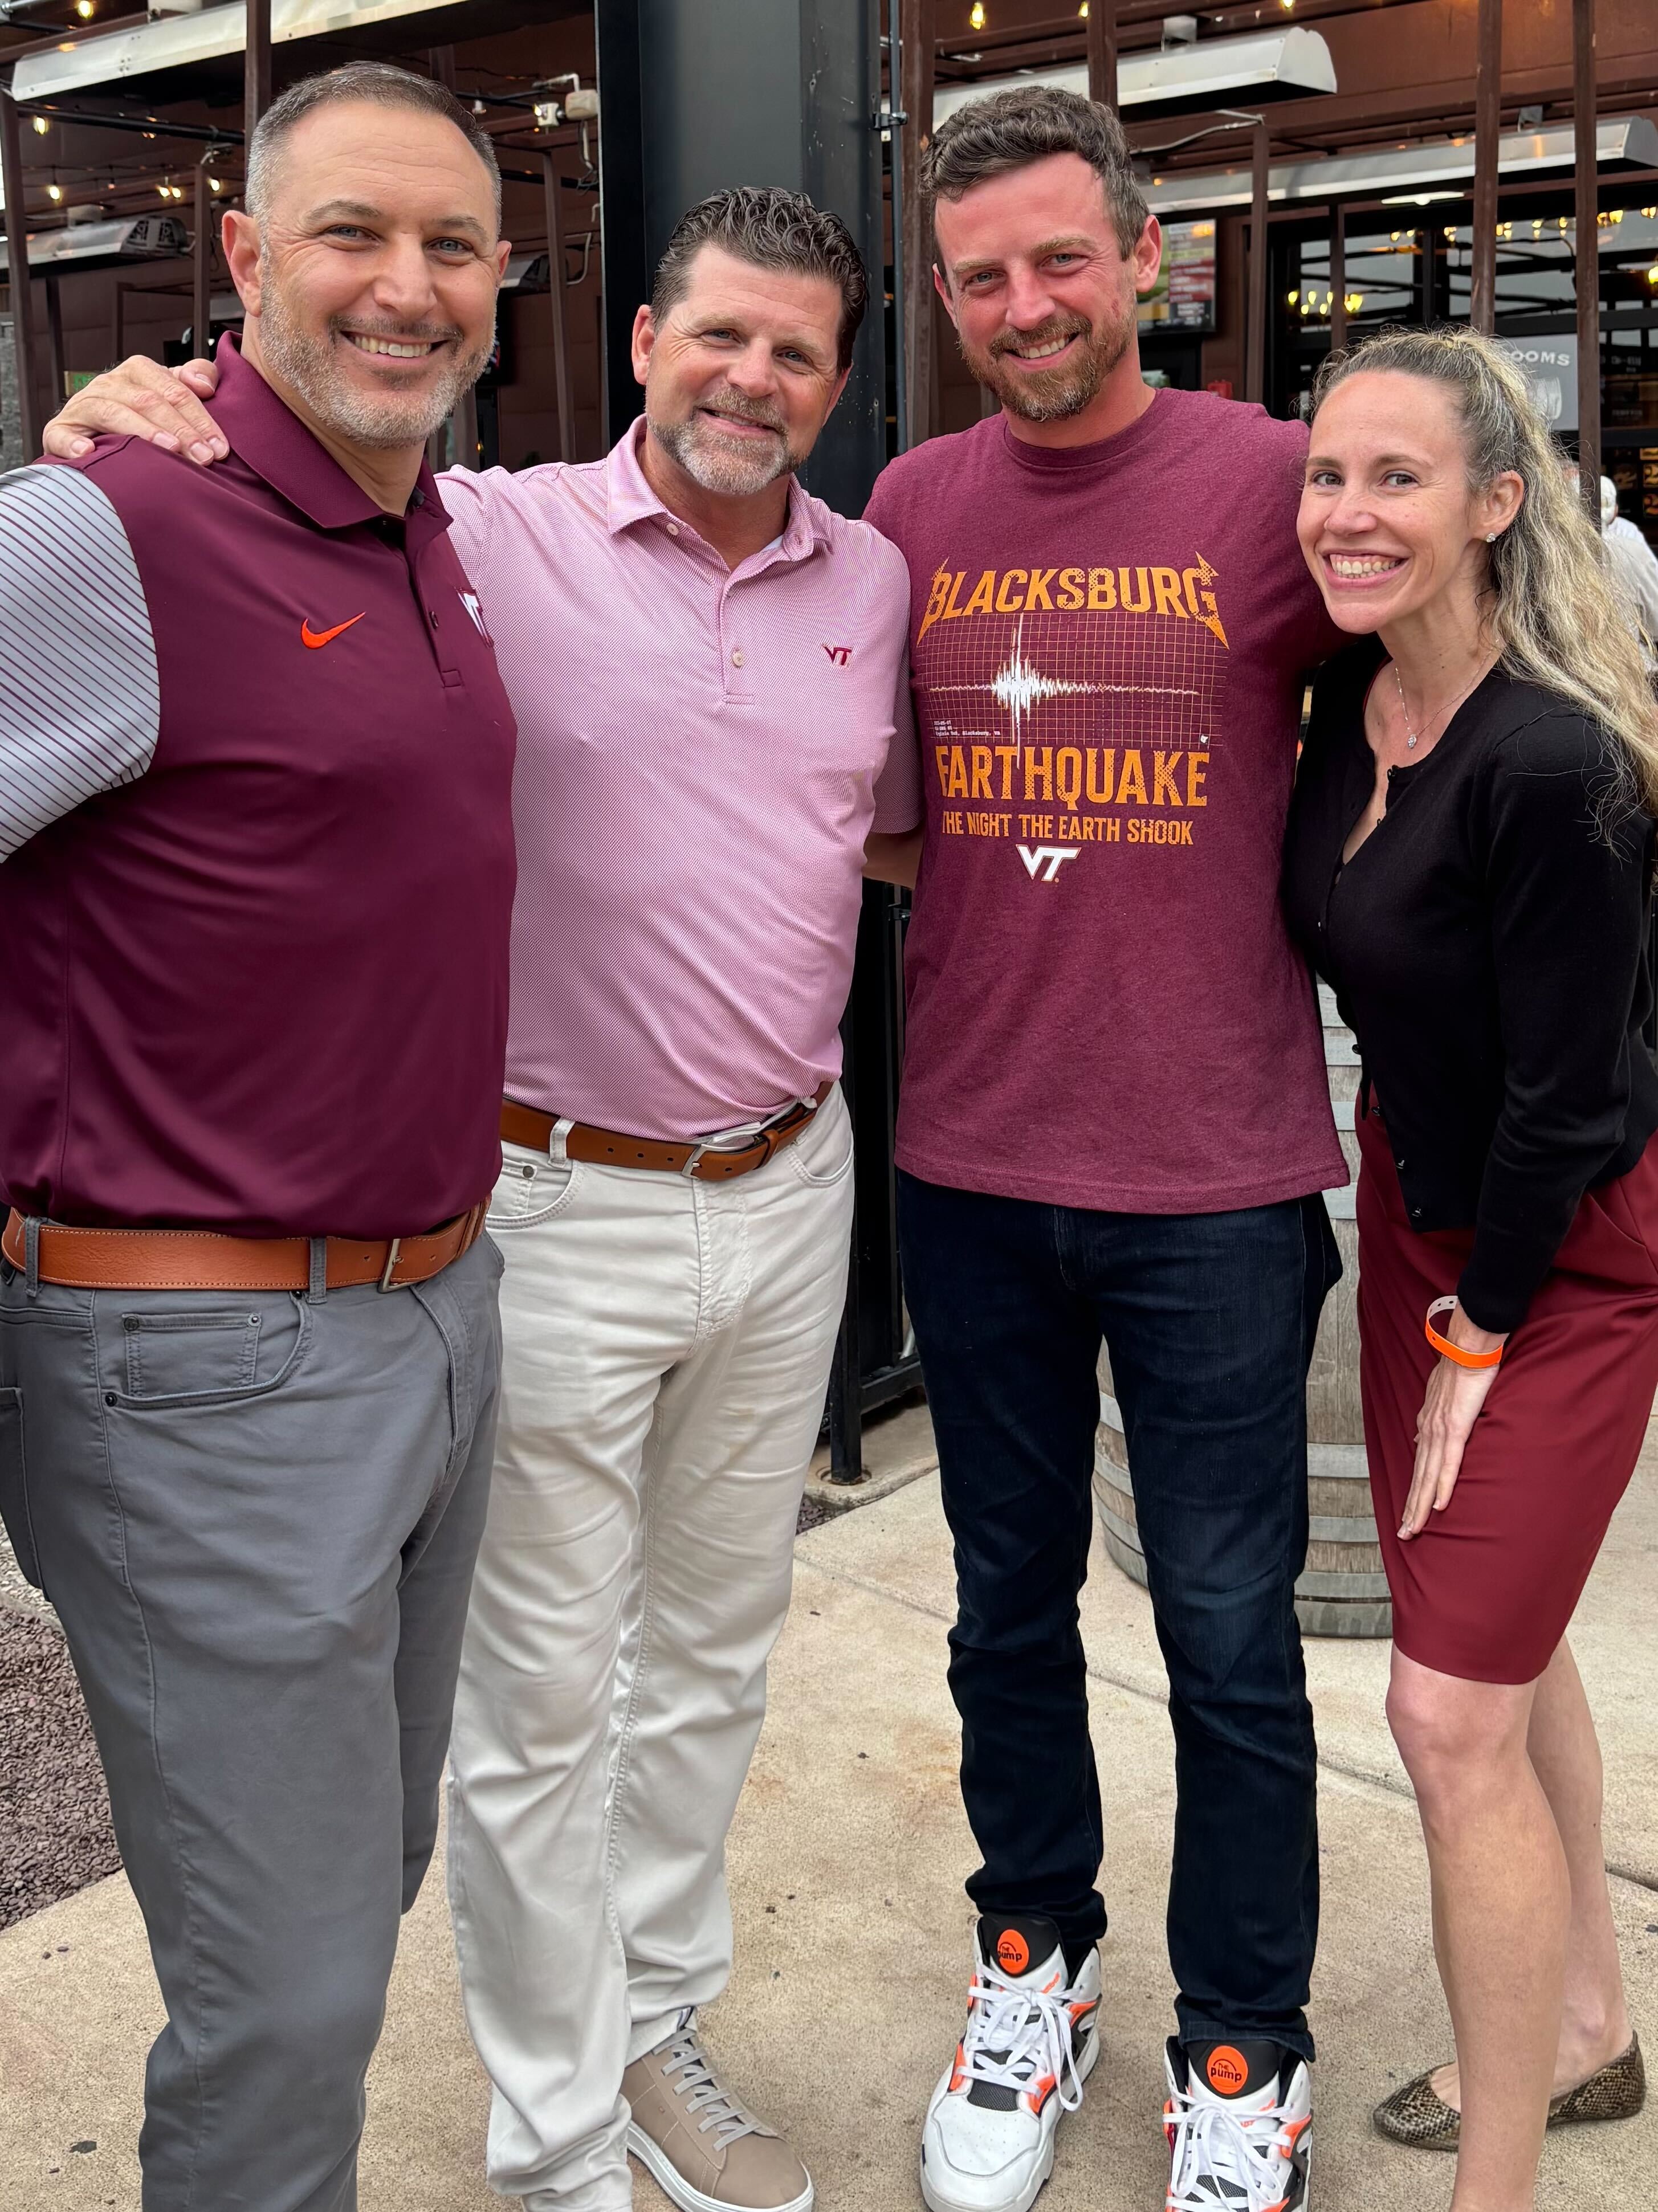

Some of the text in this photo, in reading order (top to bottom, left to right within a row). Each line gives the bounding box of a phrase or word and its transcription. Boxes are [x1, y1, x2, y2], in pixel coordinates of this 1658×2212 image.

[1510, 350, 1570, 366] OOMS
[916, 551, 1229, 650] BLACKSBURG
[821, 643, 852, 666] VT
[935, 745, 1209, 810] EARTHQUAKE
[966, 811, 1012, 837] NIGHT
[1018, 814, 1053, 838] THE
[1058, 815, 1121, 842] EARTH
[1127, 819, 1194, 846] SHOOK
[1016, 844, 1082, 882] VT
[1211, 2067, 1242, 2083] pump
